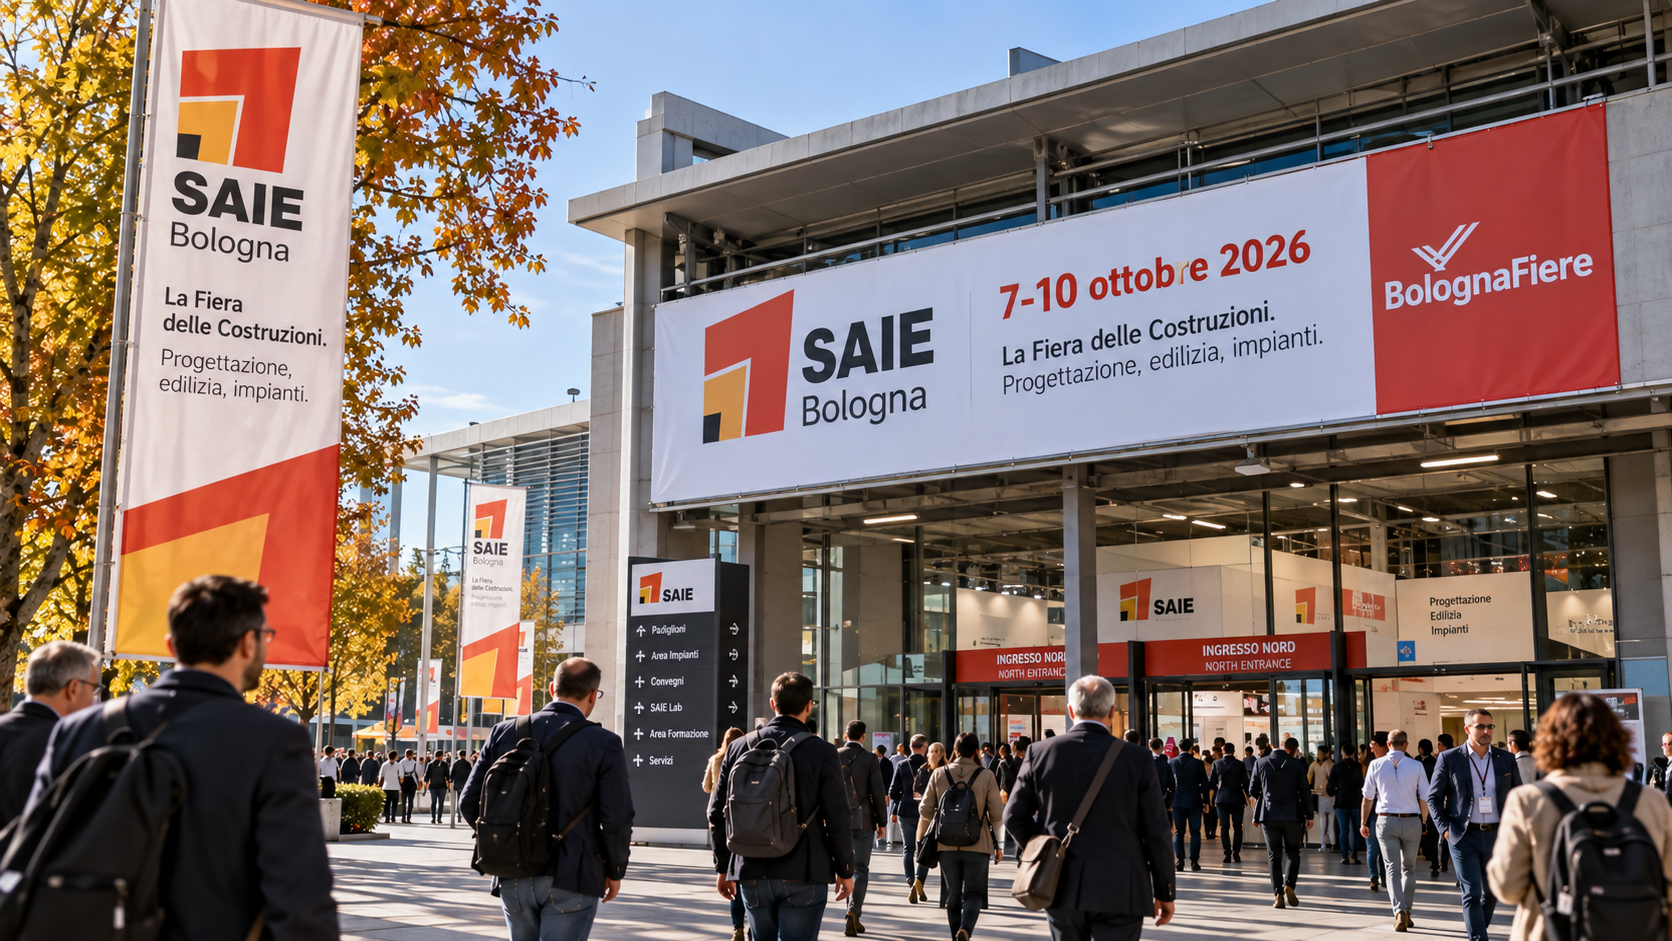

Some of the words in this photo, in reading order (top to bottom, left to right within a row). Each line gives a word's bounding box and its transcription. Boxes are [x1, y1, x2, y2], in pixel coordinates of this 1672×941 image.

[172, 171, 304, 231] SAIE
[170, 221, 289, 263] Bologna
[1000, 272, 1078, 320] 7-10
[1089, 256, 1208, 301] ottobre
[1219, 229, 1311, 278] 2026
[1384, 253, 1593, 311] BolognaFiere
[165, 287, 188, 307] La
[195, 290, 243, 313] Fiera
[163, 313, 212, 335] delle
[218, 319, 327, 347] Costruzioni.
[1002, 346, 1025, 366] La
[1033, 339, 1083, 361] Fiera
[1090, 324, 1142, 351] delle
[1149, 300, 1275, 341] Costruzioni.
[802, 307, 934, 384] SAIE
[161, 348, 292, 379] Progettazione,
[1003, 358, 1142, 395] Progettazione,
[1150, 342, 1225, 371] edilizia,
[1233, 324, 1323, 359] impianti.
[159, 375, 227, 399] edilizia,
[234, 380, 308, 403] impianti.
[803, 386, 927, 427] Bologna
[473, 541, 508, 556] SAIE
[473, 556, 504, 568] Bologna
[662, 588, 694, 602] SAIE
[1429, 594, 1492, 608] Progettazione
[1154, 597, 1195, 615] SAIE
[651, 624, 686, 636] Padiglioni
[1431, 624, 1469, 637] Impianti
[651, 651, 668, 660] Area
[669, 649, 699, 661] Impianti
[1202, 643, 1259, 656] INGRESSO
[1262, 641, 1296, 654] NORD
[996, 652, 1042, 665] INGRESSO
[1044, 651, 1066, 663] NOR
[1205, 660, 1238, 671] NORTH
[1241, 658, 1292, 670] ENTRANCE
[998, 668, 1025, 679] NORTH
[1027, 667, 1066, 678] ENTRANC
[650, 676, 684, 688] Convegni
[650, 702, 667, 712] SAIE
[669, 702, 683, 712] Lab
[649, 729, 666, 738] Area
[668, 729, 709, 738] Formazione
[649, 755, 674, 765] Servizi
